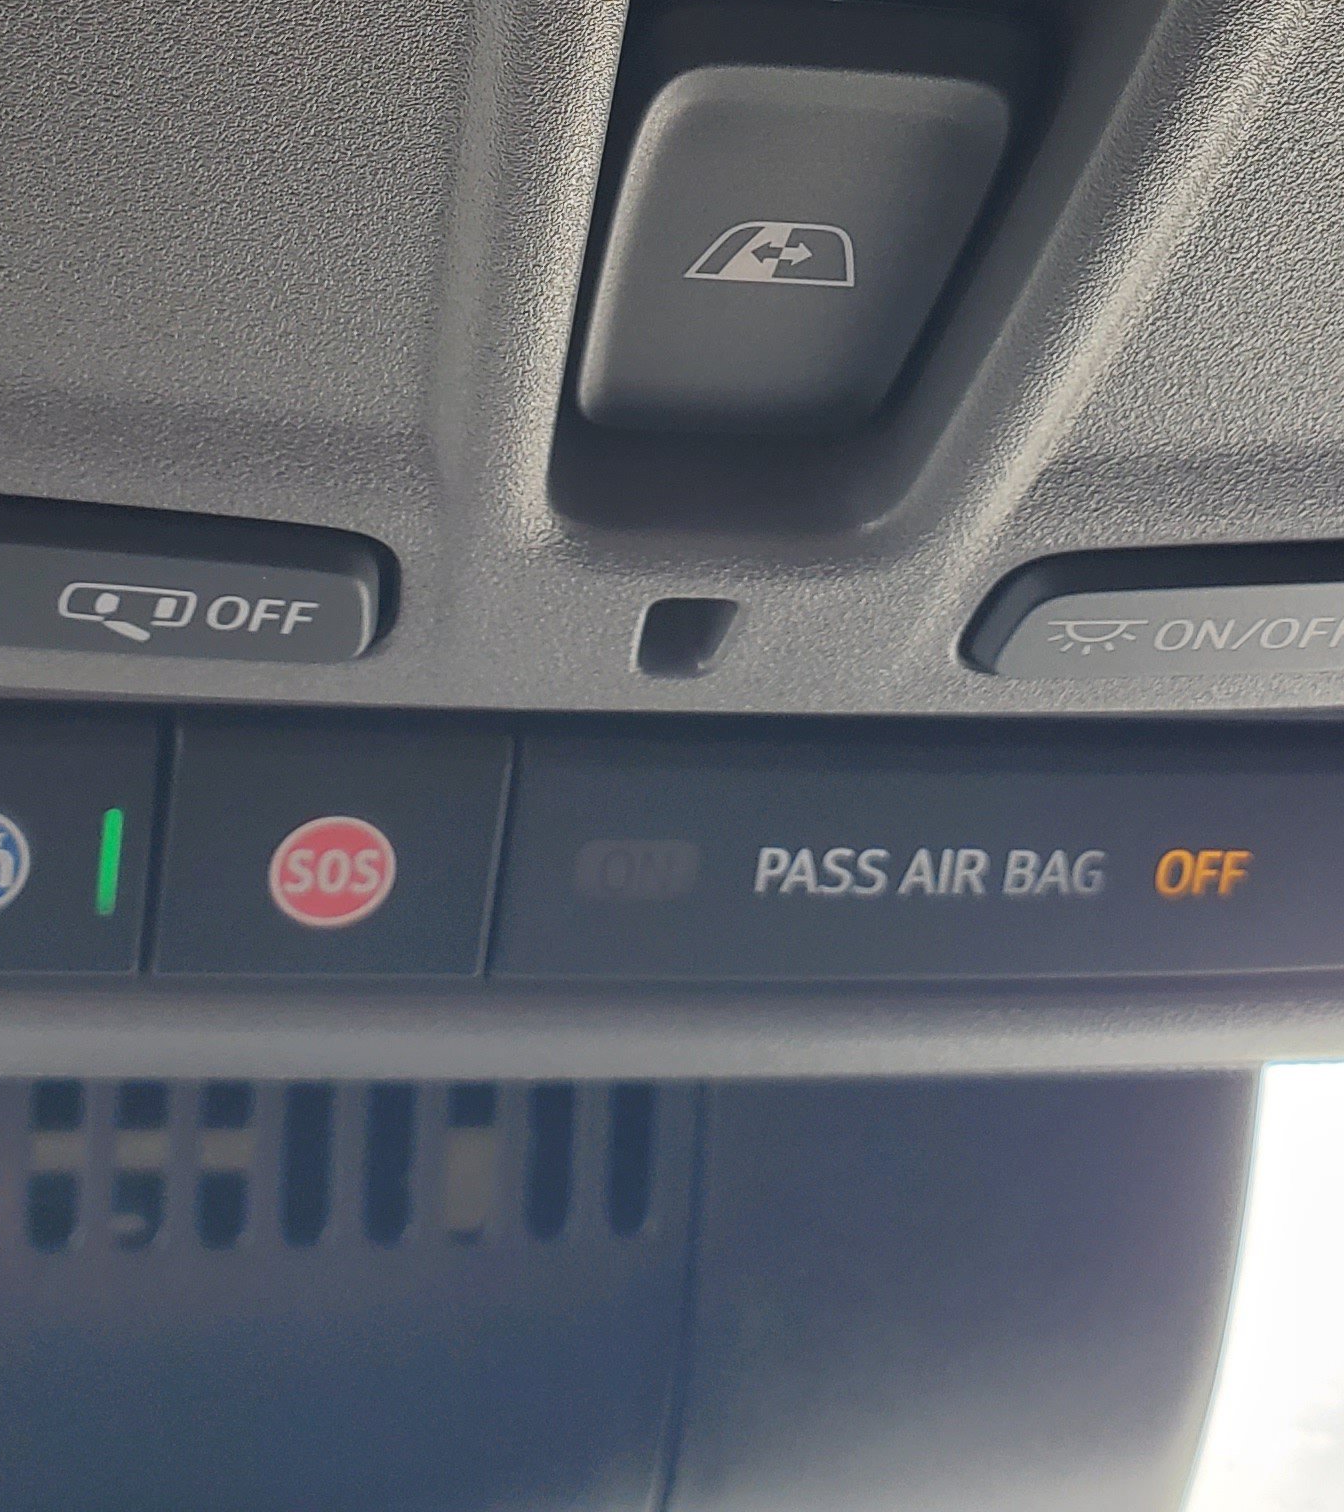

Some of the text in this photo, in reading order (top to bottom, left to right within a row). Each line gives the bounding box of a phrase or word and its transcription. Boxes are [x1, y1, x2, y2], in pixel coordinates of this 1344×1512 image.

[205, 594, 320, 635] OFF
[284, 848, 381, 895] SOS
[755, 847, 1253, 895] PASS AIR BAG OFF
